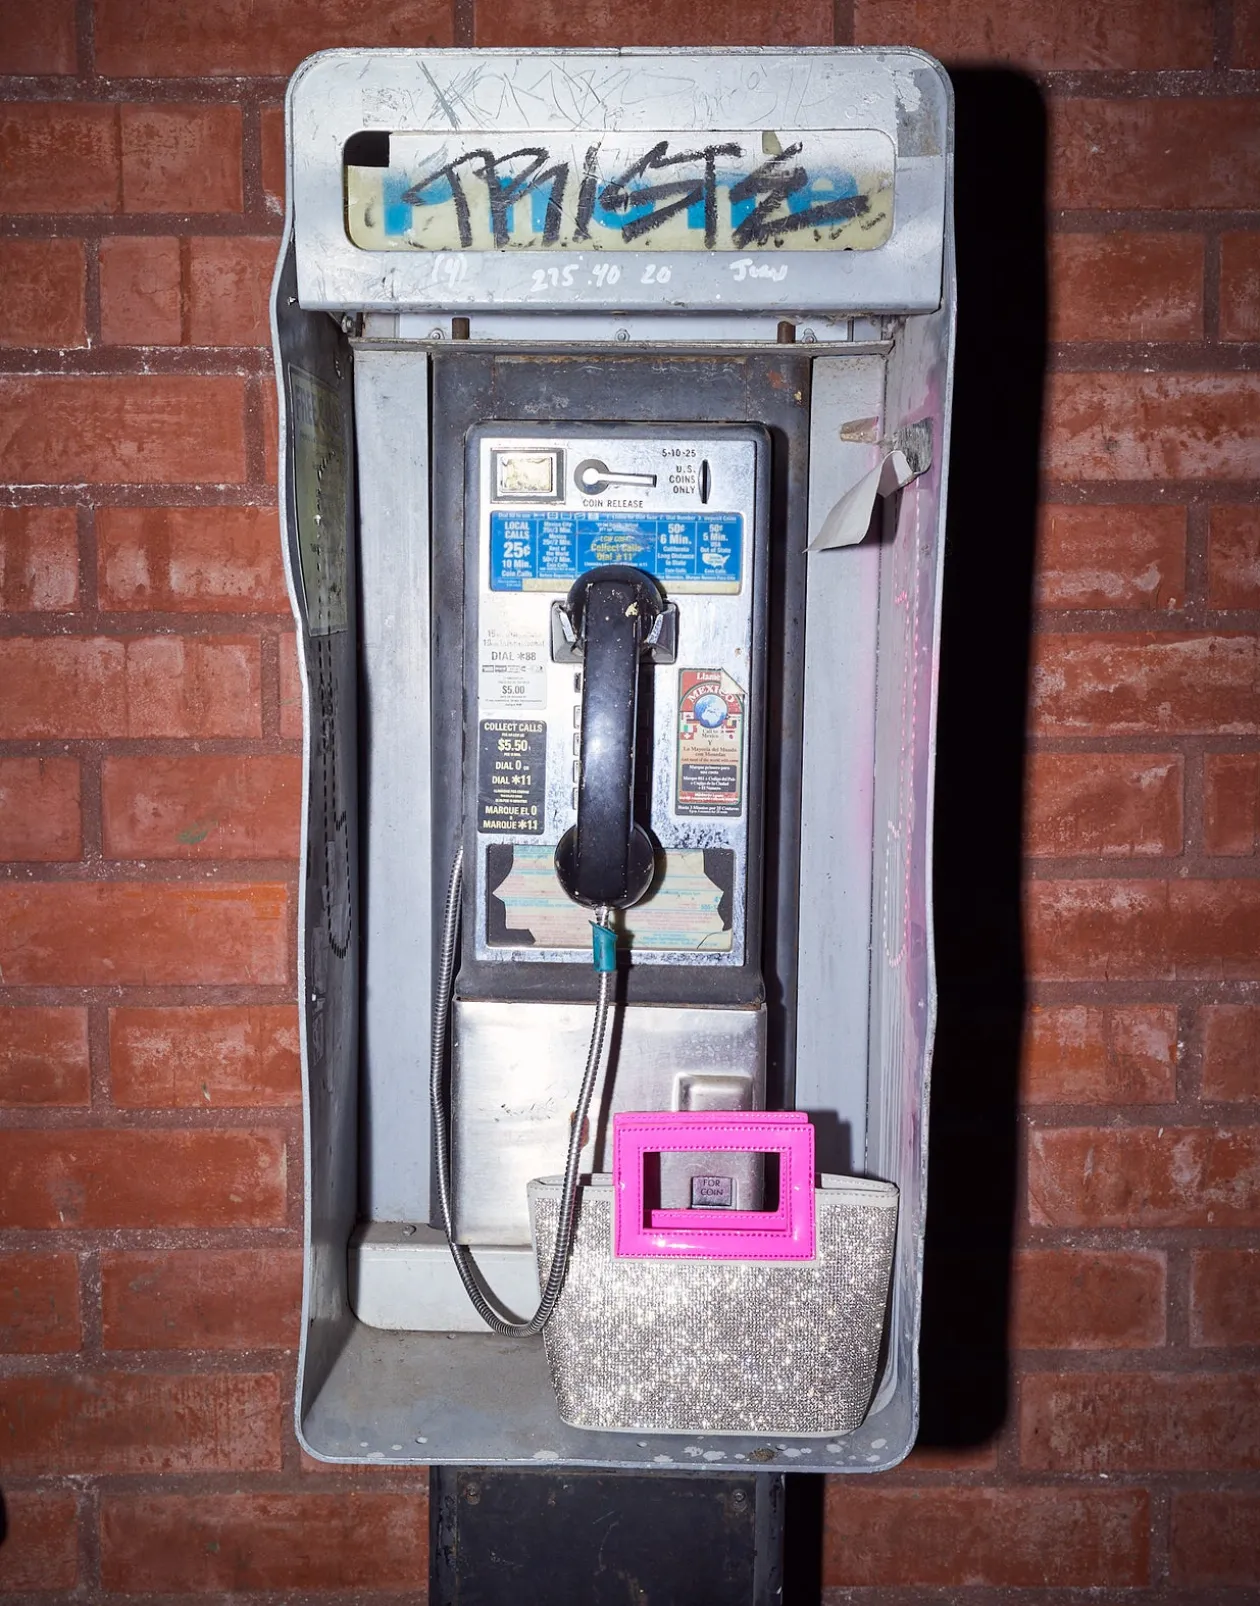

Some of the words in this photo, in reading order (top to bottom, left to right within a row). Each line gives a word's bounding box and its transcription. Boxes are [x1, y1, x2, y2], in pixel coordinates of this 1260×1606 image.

[662, 449, 696, 457] 5-10-25
[669, 475, 695, 483] COINS
[673, 486, 695, 494] ONLY
[583, 499, 602, 507] COIN
[608, 499, 643, 508] RELEASE
[505, 521, 529, 530] LOCAL
[668, 523, 685, 533] 50¢
[505, 530, 529, 539] CALLS
[660, 534, 667, 544] 6
[669, 534, 692, 544] Min.
[710, 533, 728, 541] Min.
[503, 542, 531, 558] 25¢
[502, 560, 512, 568] 10
[513, 559, 532, 568] Min.
[491, 651, 514, 661] DIAL
[502, 685, 525, 694] $5.00
[484, 722, 517, 731] COLLECT
[519, 723, 542, 733] CALLS
[498, 739, 528, 751] $5.50
[496, 761, 513, 770] DIAL
[515, 760, 521, 770] 0
[492, 775, 509, 784] DIAL
[485, 806, 519, 814] MARQUE
[521, 807, 529, 815] EL
[531, 806, 537, 815] 0
[483, 820, 516, 829] MARQUE
